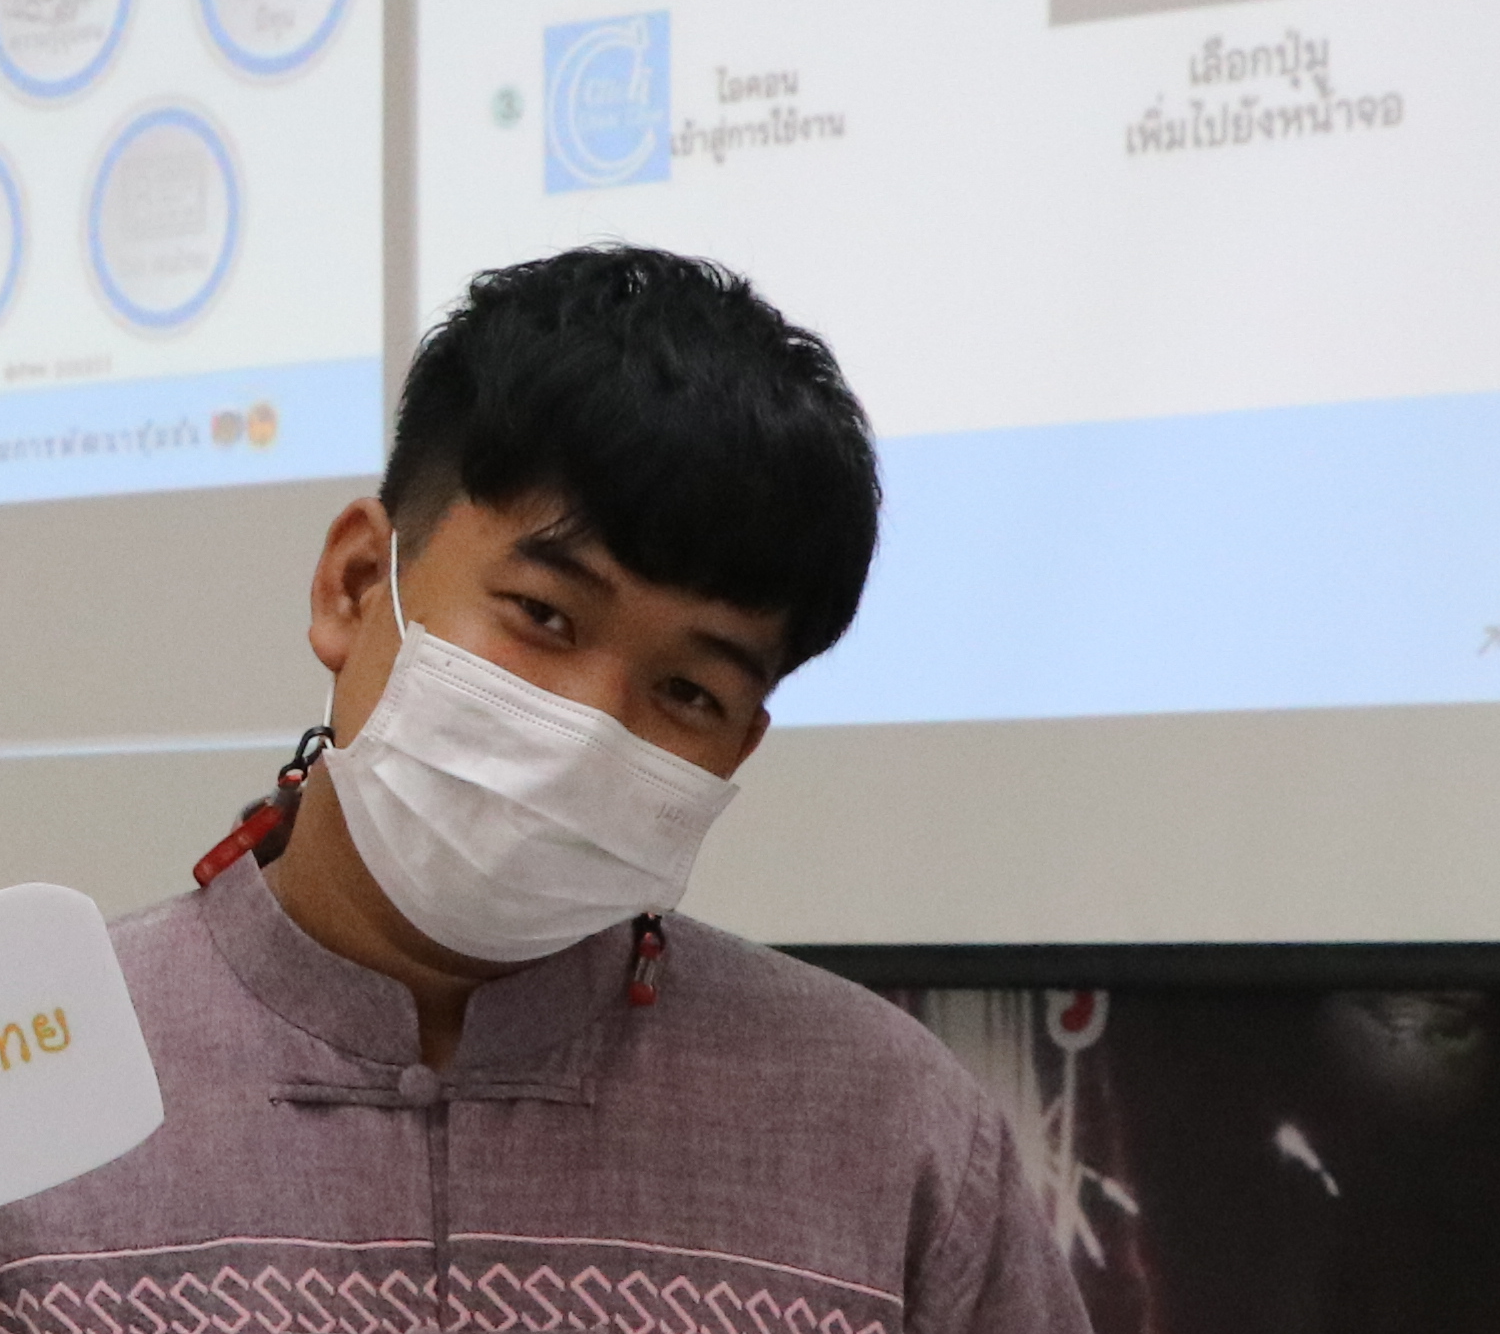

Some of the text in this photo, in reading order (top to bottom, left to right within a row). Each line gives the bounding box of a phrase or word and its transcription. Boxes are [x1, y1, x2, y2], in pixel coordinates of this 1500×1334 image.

[1125, 92, 1404, 156] เพิ่มไปยังหน้าจอ
